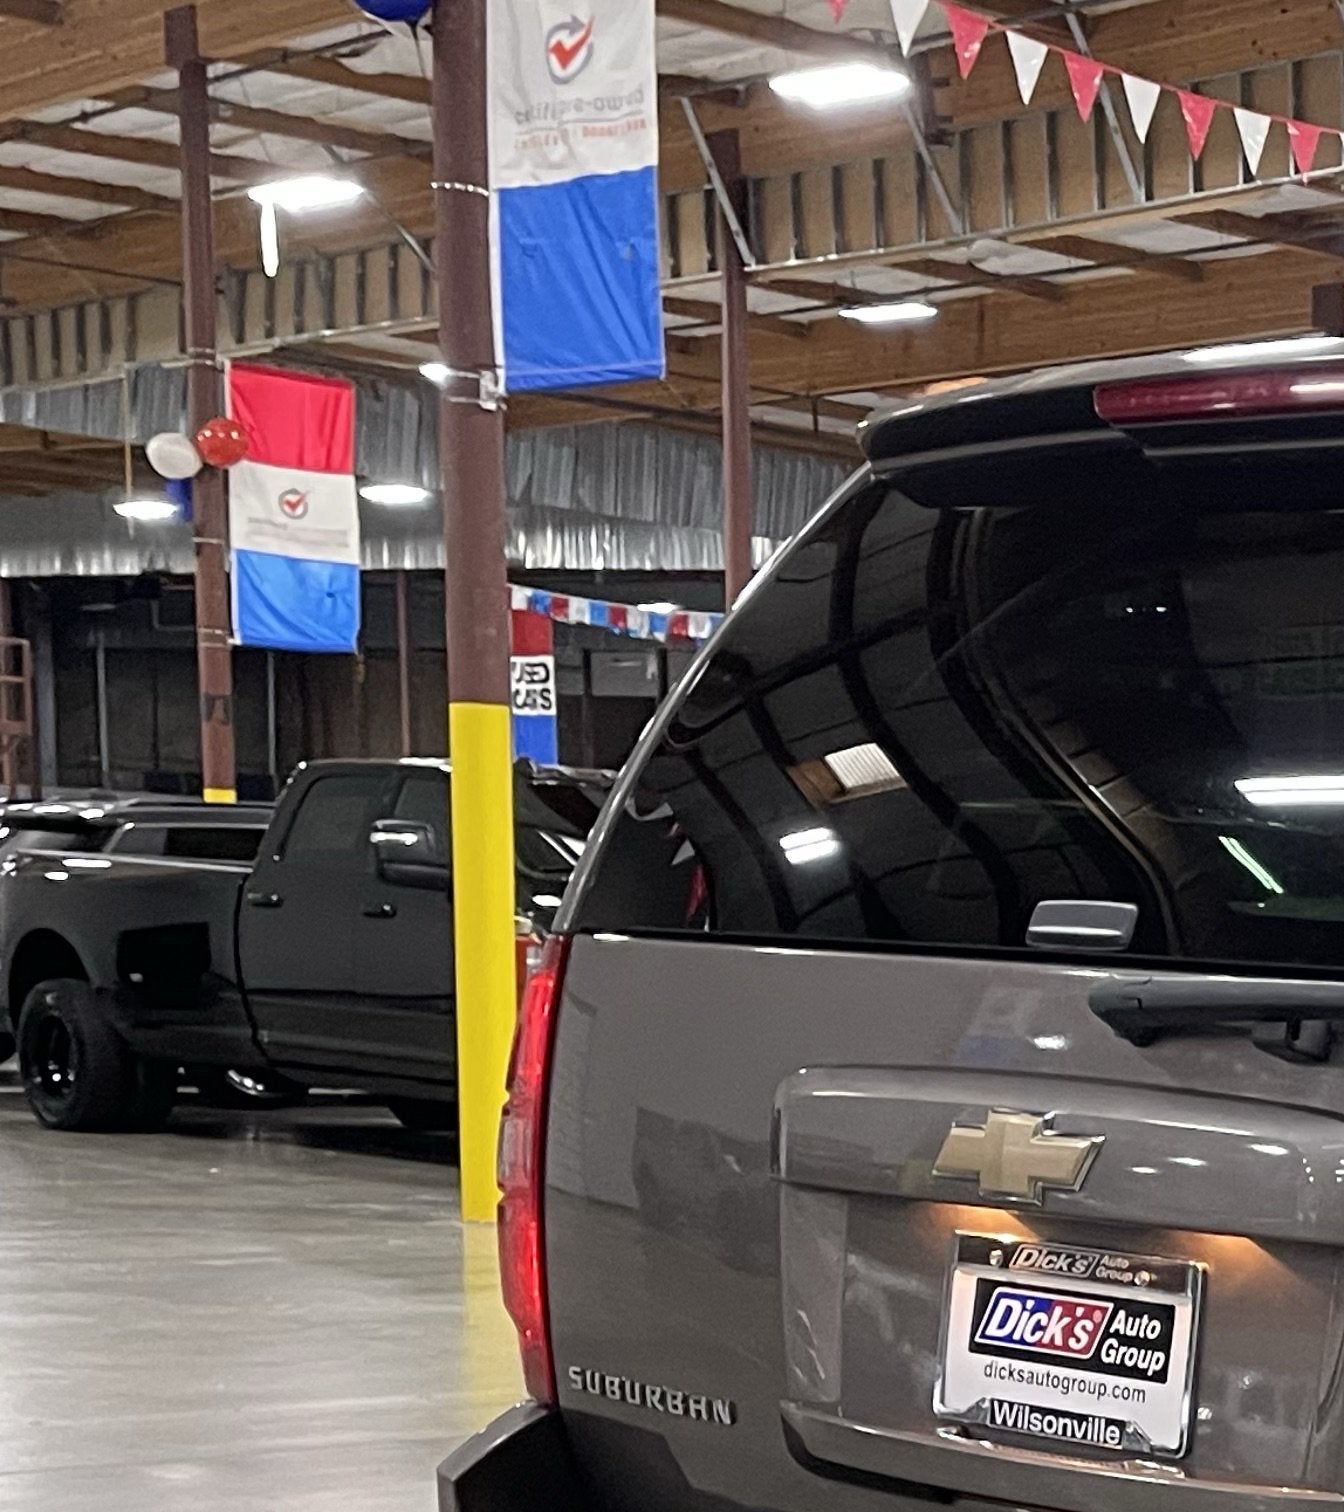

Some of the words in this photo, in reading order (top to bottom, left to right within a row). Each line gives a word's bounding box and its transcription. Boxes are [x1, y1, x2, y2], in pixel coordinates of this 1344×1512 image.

[1095, 1266, 1134, 1283] Group
[1099, 1254, 1130, 1269] Auto
[984, 1297, 1095, 1351] Dick's
[1109, 1309, 1162, 1340] Auto
[1101, 1337, 1166, 1377] Group
[567, 1365, 735, 1426] SUBURBAN
[983, 1360, 1147, 1404] dicksautogroup.com
[993, 1399, 1121, 1445] Wilsonville
